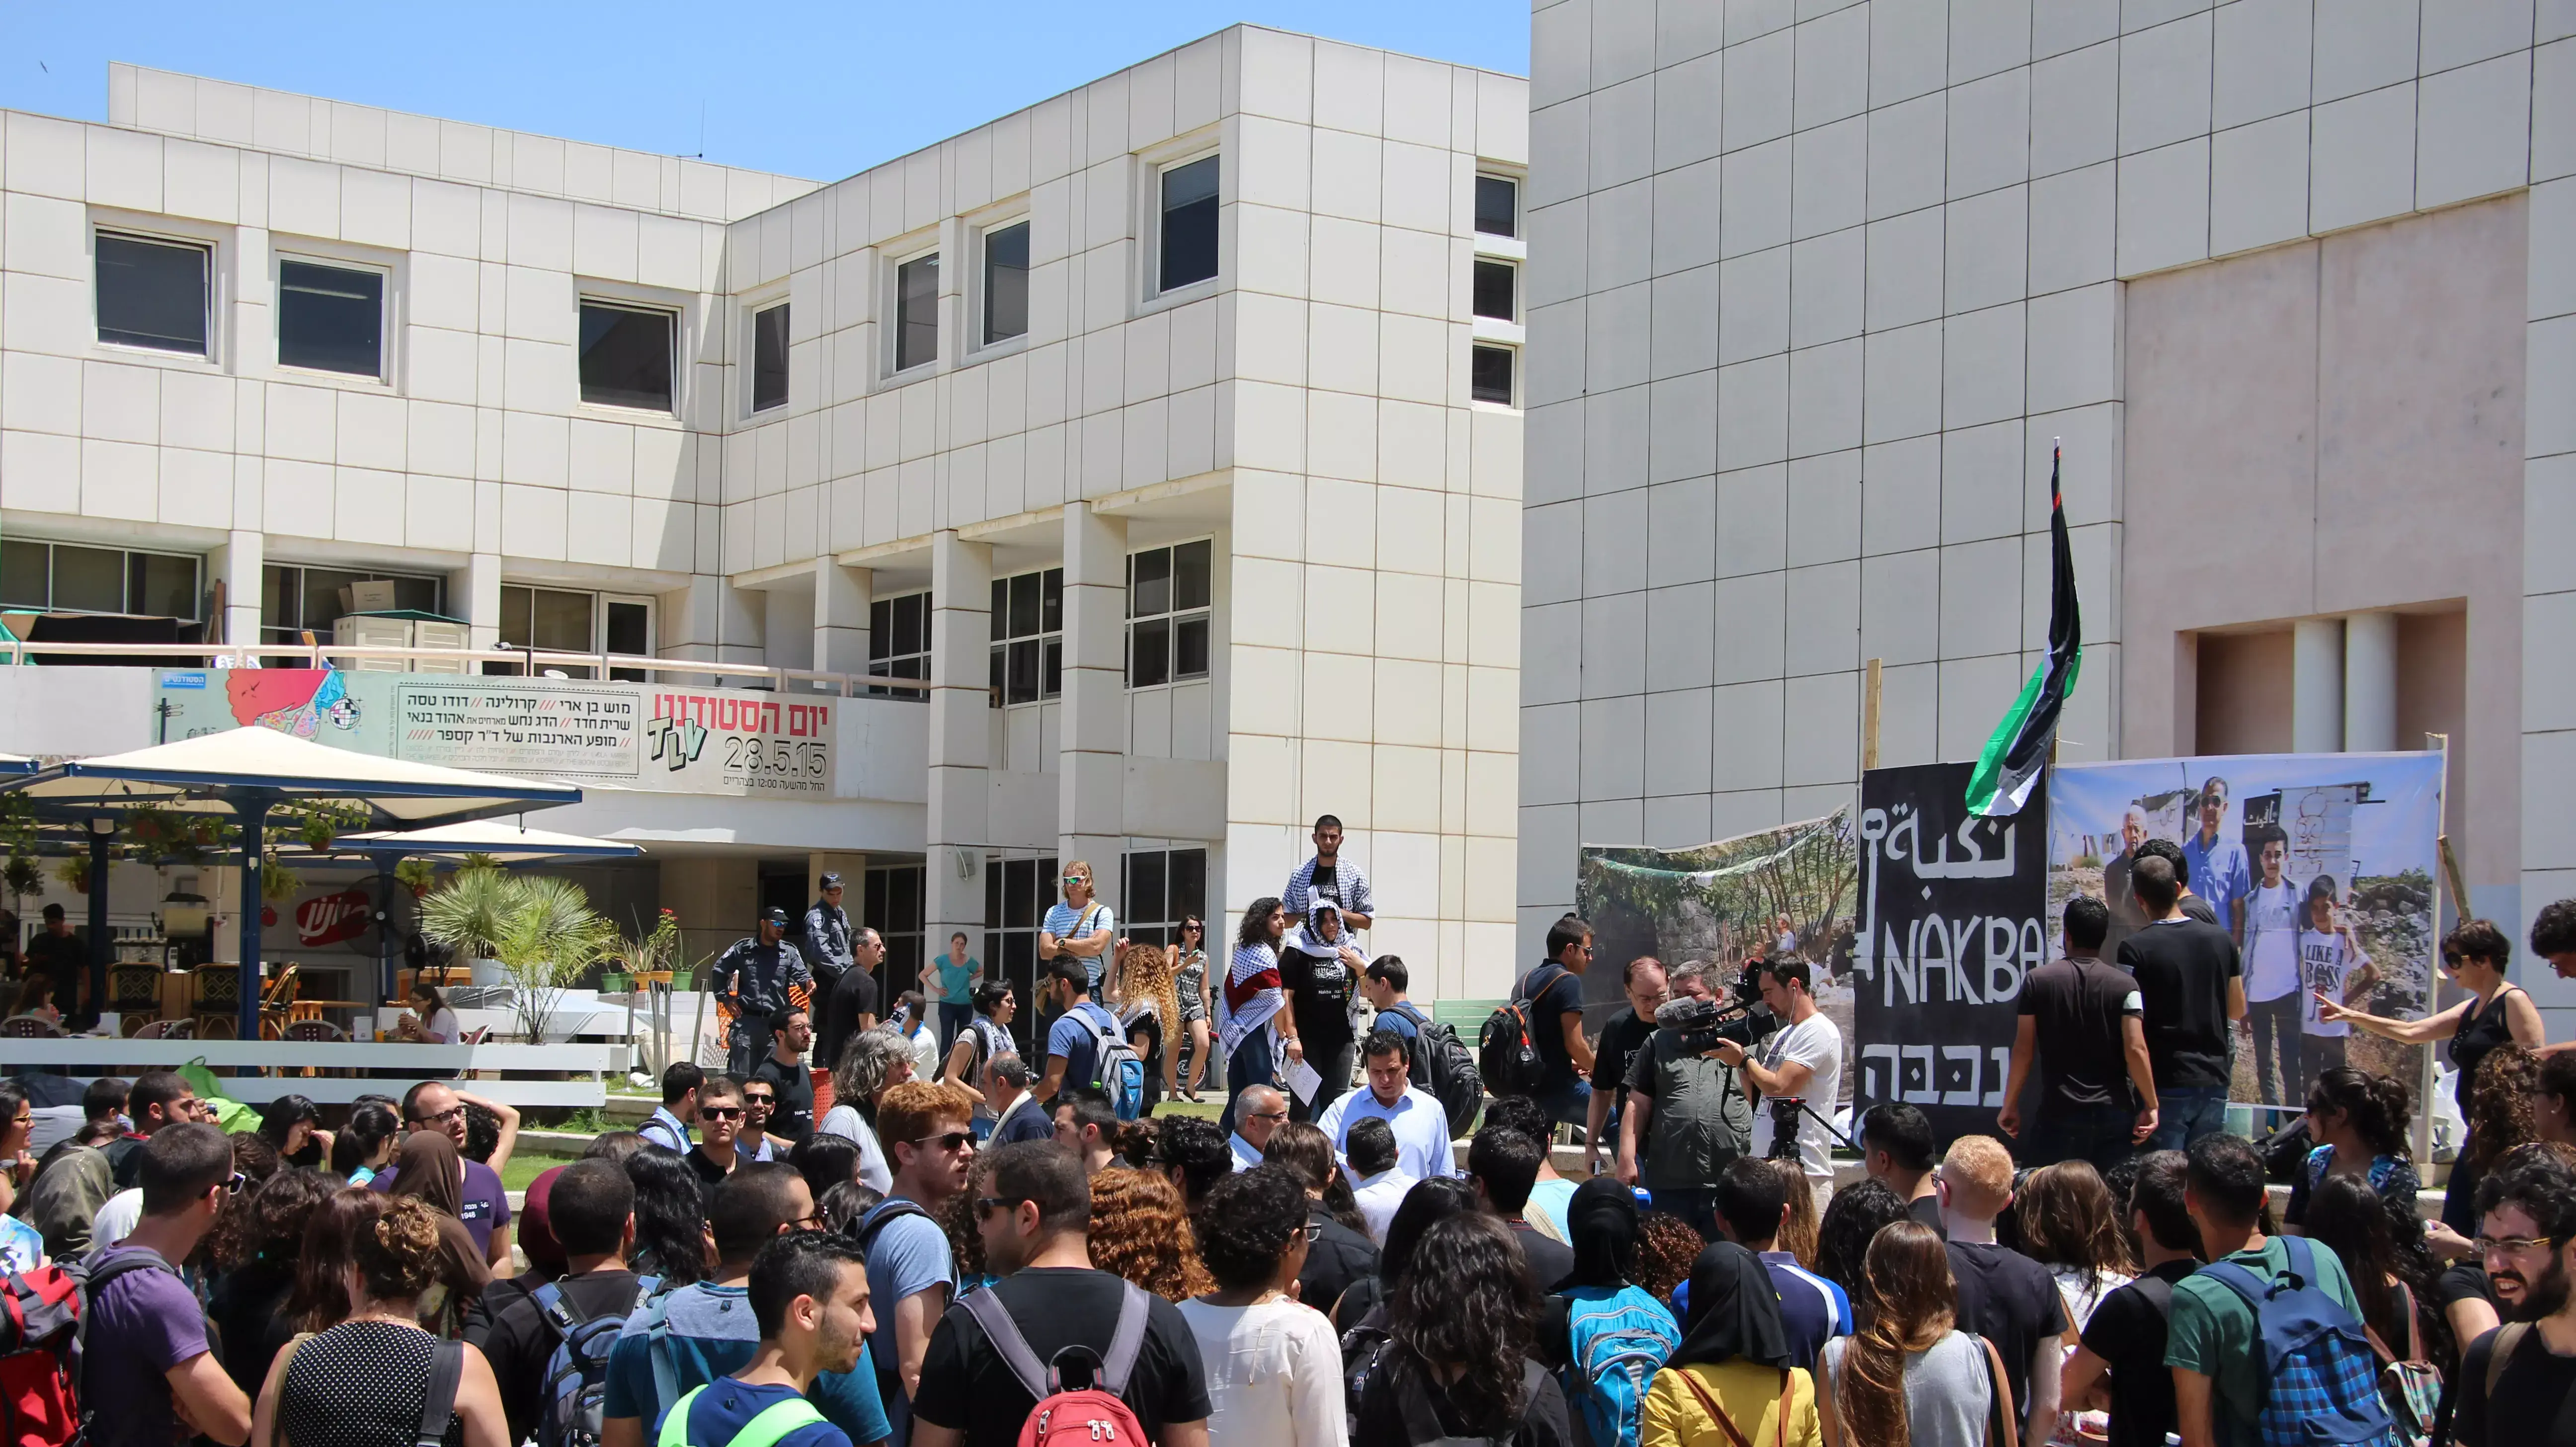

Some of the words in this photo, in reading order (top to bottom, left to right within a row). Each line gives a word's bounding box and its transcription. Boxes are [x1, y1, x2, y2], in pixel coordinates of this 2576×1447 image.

[407, 695, 437, 706] טסה
[442, 696, 469, 707] דודו
[486, 695, 537, 713] קרולינה
[560, 700, 581, 712] ארי
[586, 701, 599, 716] בן
[604, 702, 631, 714] מוש
[407, 712, 433, 723] בנאי
[435, 713, 465, 724] אהוד
[478, 717, 506, 725] מארחים
[508, 715, 532, 726] נחש
[535, 716, 558, 727] הדג
[573, 718, 596, 729] חדד
[788, 704, 828, 737] יום
[599, 720, 630, 731] שרית
[437, 730, 474, 745] קספר
[504, 728, 523, 742] של
[527, 732, 582, 745] הארנבות
[586, 735, 617, 747] מופע
[647, 716, 708, 772] TLV
[724, 736, 826, 778] 28.5.15
[724, 776, 753, 787] בצהריים
[757, 779, 777, 788] 12:00
[780, 780, 807, 791] מהשעה
[810, 780, 825, 792] החל
[1885, 802, 2015, 900] نكبة
[1883, 913, 2045, 1007] NAKBA
[2305, 945, 2333, 963] LIKE
[2335, 949, 2343, 966] A
[2305, 962, 2340, 990] BOSS
[1861, 1044, 2010, 1107] נכבה
[461, 1211, 477, 1219] 1948
